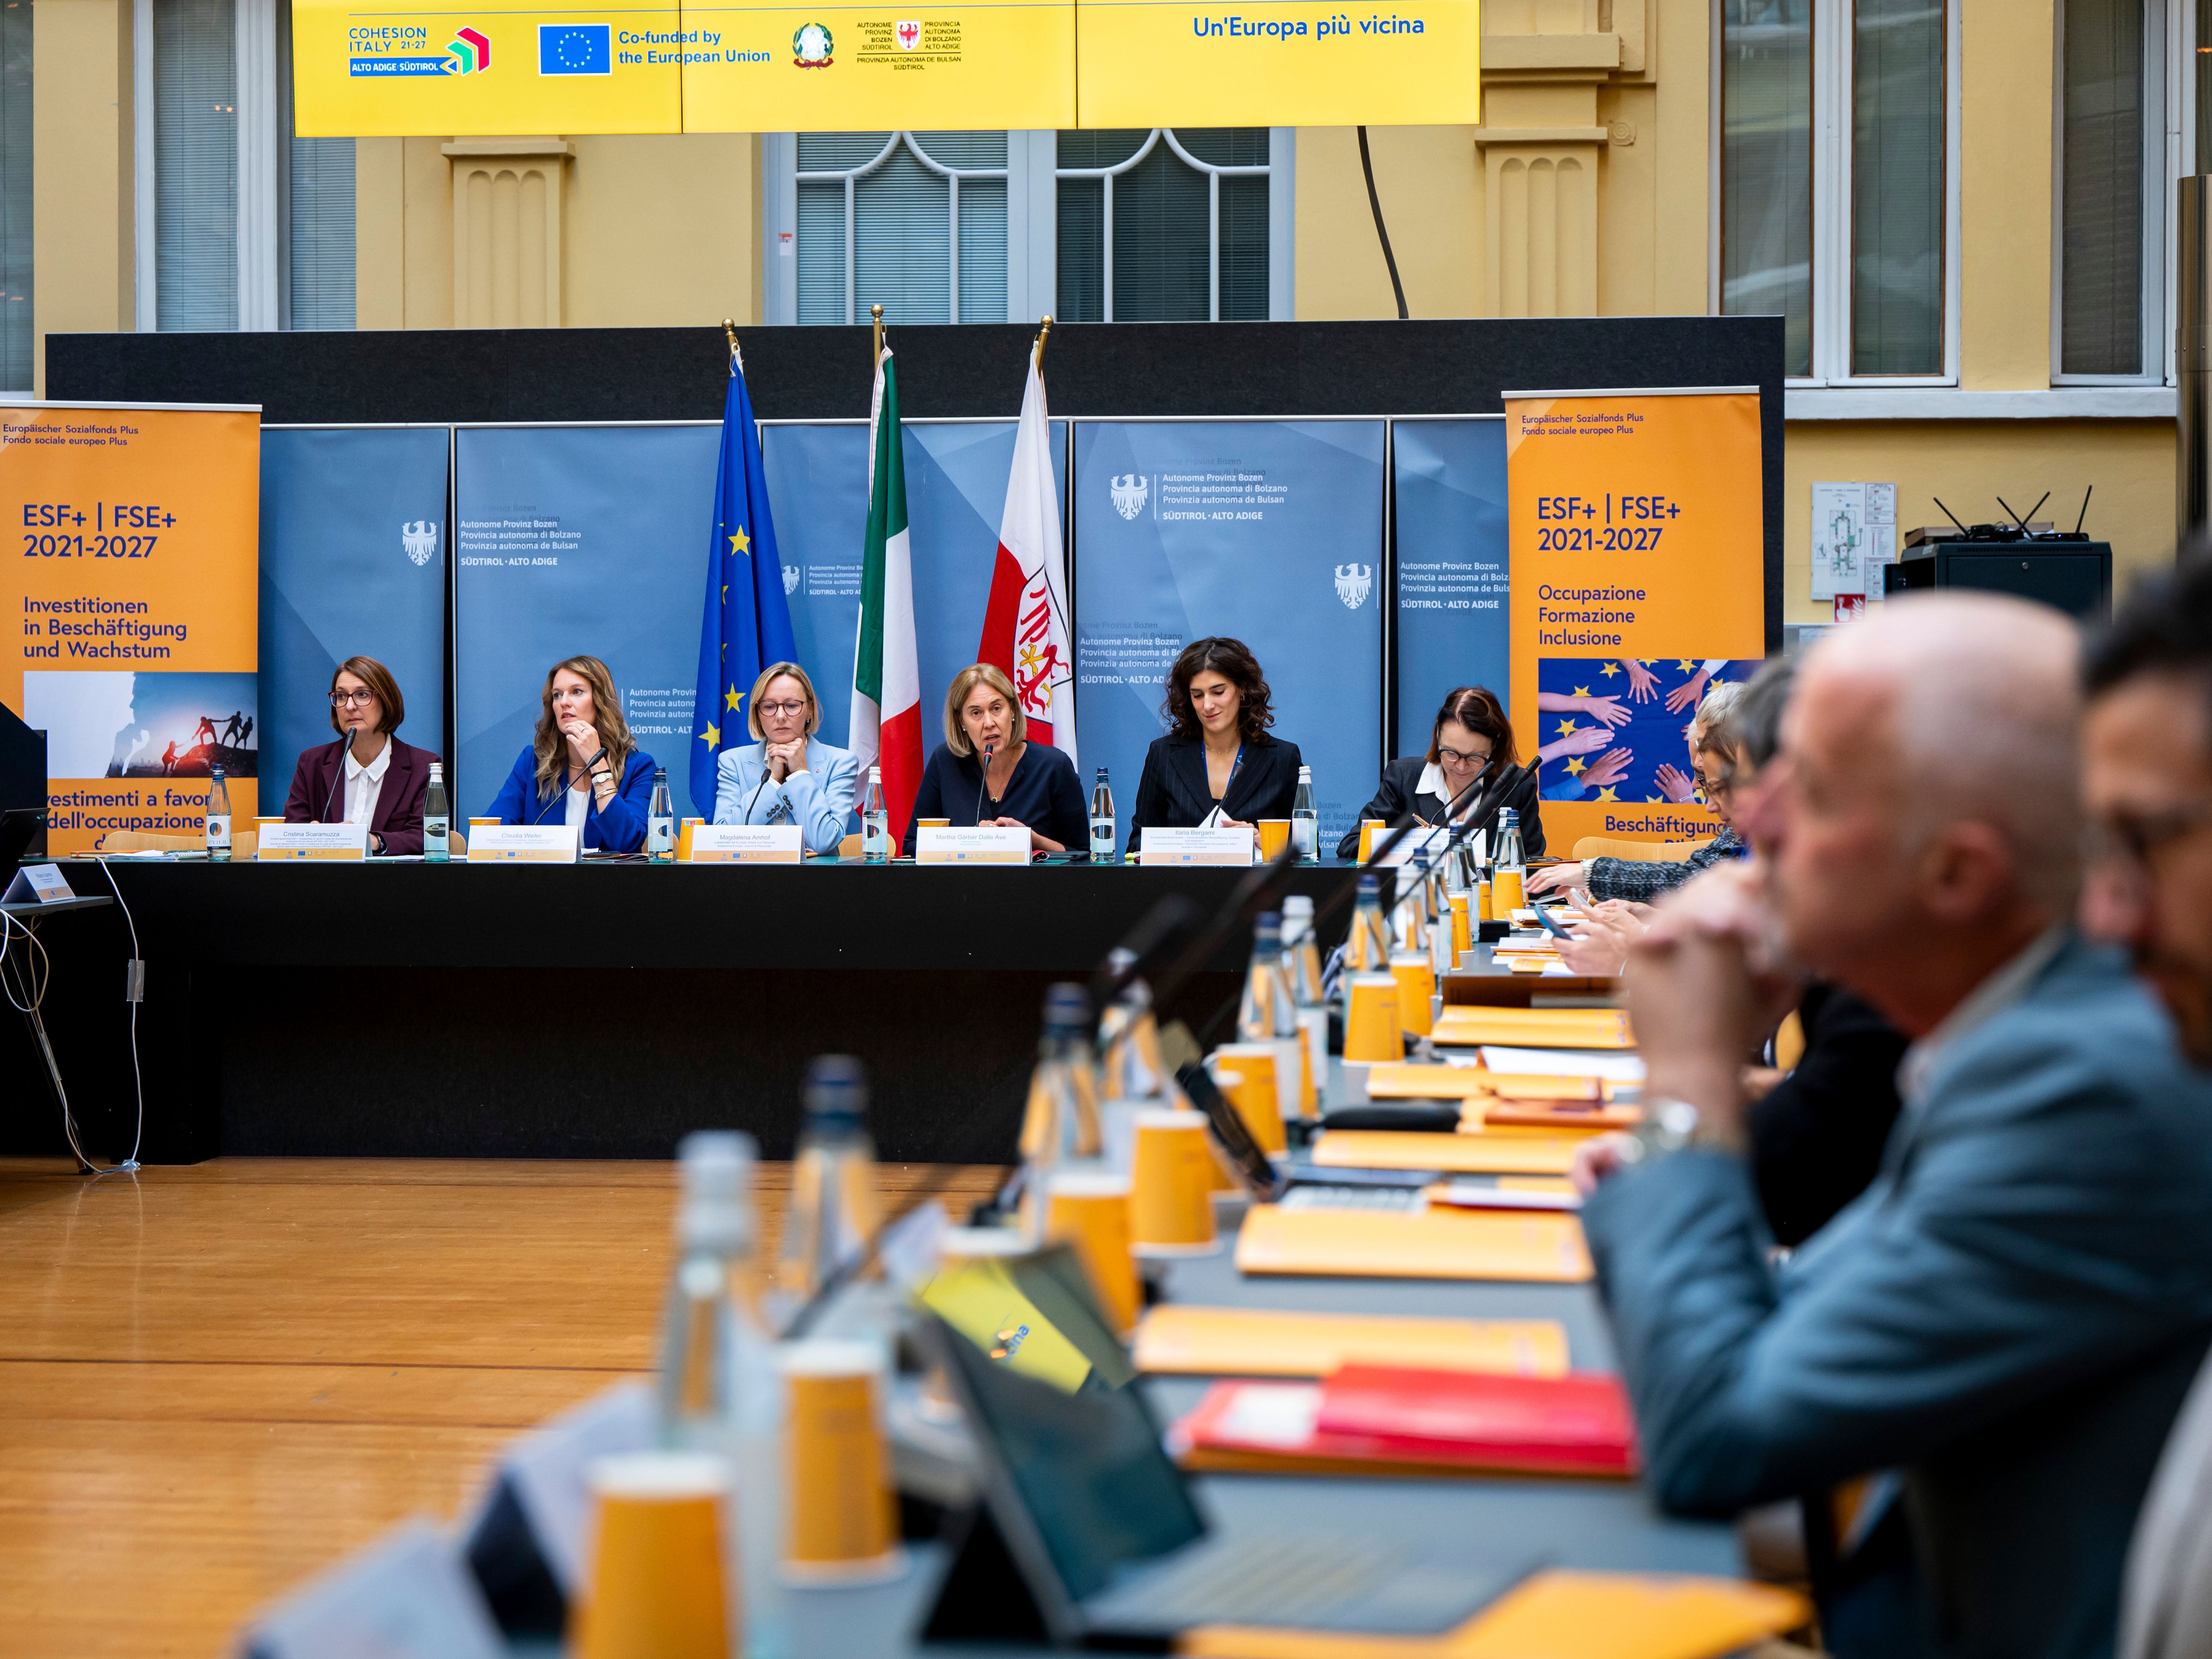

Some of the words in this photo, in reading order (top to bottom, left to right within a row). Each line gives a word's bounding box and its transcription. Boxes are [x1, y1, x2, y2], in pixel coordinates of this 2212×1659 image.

[349, 27, 426, 38] COHESION
[1194, 16, 1307, 41] Un'Europa
[1318, 14, 1350, 41] più
[1359, 15, 1424, 34] vicina
[619, 30, 697, 43] Co-funded
[703, 30, 721, 46] by
[350, 41, 391, 52] ITALY
[401, 41, 425, 49] 21-27
[619, 51, 642, 63] the
[648, 51, 720, 65] European
[726, 49, 770, 62] Union
[352, 63, 371, 71] ALTO
[373, 63, 397, 71] ADIGE
[400, 61, 438, 71] SÜDTIROL
[1522, 414, 1573, 425] Europäischer
[1577, 414, 1624, 422] Sozialfonds
[1627, 413, 1643, 422] Plus
[3, 424, 62, 434] Europäischer
[66, 425, 116, 434] Sozialfonds
[120, 426, 138, 434] Plus
[1522, 427, 1545, 435] Fondo
[1549, 426, 1576, 435] sociale
[1580, 427, 1614, 436] europeo
[1616, 426, 1633, 434] Plus
[3, 436, 31, 444] Fondo
[35, 436, 65, 445] sociale
[69, 437, 106, 447] europeo
[109, 437, 127, 446] Plus
[1163, 474, 1205, 482] Autonome
[1207, 474, 1236, 482] Provinz
[1245, 484, 1253, 493] di
[1255, 484, 1288, 493] Bolzano
[1538, 497, 1596, 520] ESF+
[1622, 496, 1681, 519] FSE+
[24, 504, 87, 527] ESF+
[115, 506, 176, 528] FSE+
[1163, 511, 1207, 520] SÜDTIROL
[24, 534, 158, 558] 2021-2027
[1538, 528, 1663, 551] 2021-2027
[461, 556, 503, 566] SÜDTIROL
[1481, 584, 1491, 592] de
[1538, 585, 1646, 604] Occupazione
[24, 596, 147, 614] Investitionen
[1401, 598, 1442, 608] SÜDTIROL
[1539, 607, 1635, 623] Formazione
[24, 619, 40, 635] in
[49, 618, 187, 641] Beschäftigung
[1539, 629, 1622, 645] Inclusione
[24, 640, 59, 658] und
[68, 641, 170, 658] Wachstum
[1080, 674, 1123, 683] SÜDTIROL
[630, 725, 672, 733] SÜDTIROL
[47, 790, 138, 806] estimenti
[147, 795, 157, 806] a
[165, 789, 208, 806] favor
[47, 812, 204, 832] dell'occupazione
